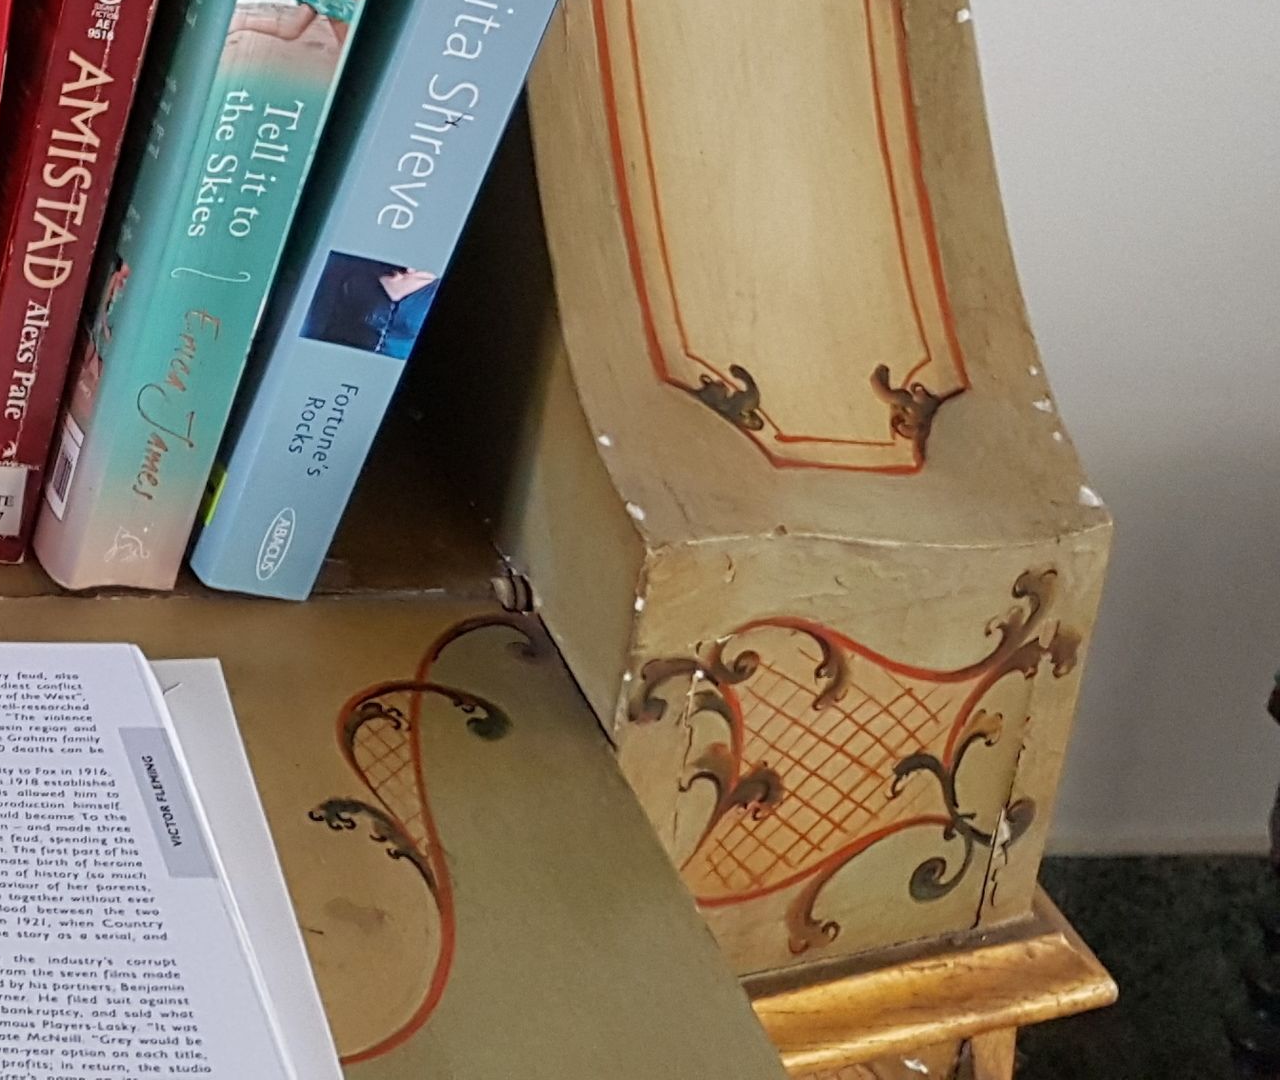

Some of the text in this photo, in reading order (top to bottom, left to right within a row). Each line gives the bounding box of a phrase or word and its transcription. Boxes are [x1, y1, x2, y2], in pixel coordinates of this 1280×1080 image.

[23, 50, 115, 290] AMISTAD
[188, 89, 254, 239] the Skies
[230, 99, 304, 239] Tell it to
[377, 75, 481, 231] Shreve
[16, 300, 51, 363] Alexs
[5, 369, 36, 422] Pate
[288, 396, 326, 455] Rocks
[307, 382, 358, 478] Fortune's
[259, 518, 291, 572] ABACUS
[141, 755, 182, 847] VICTOR FLEMING
